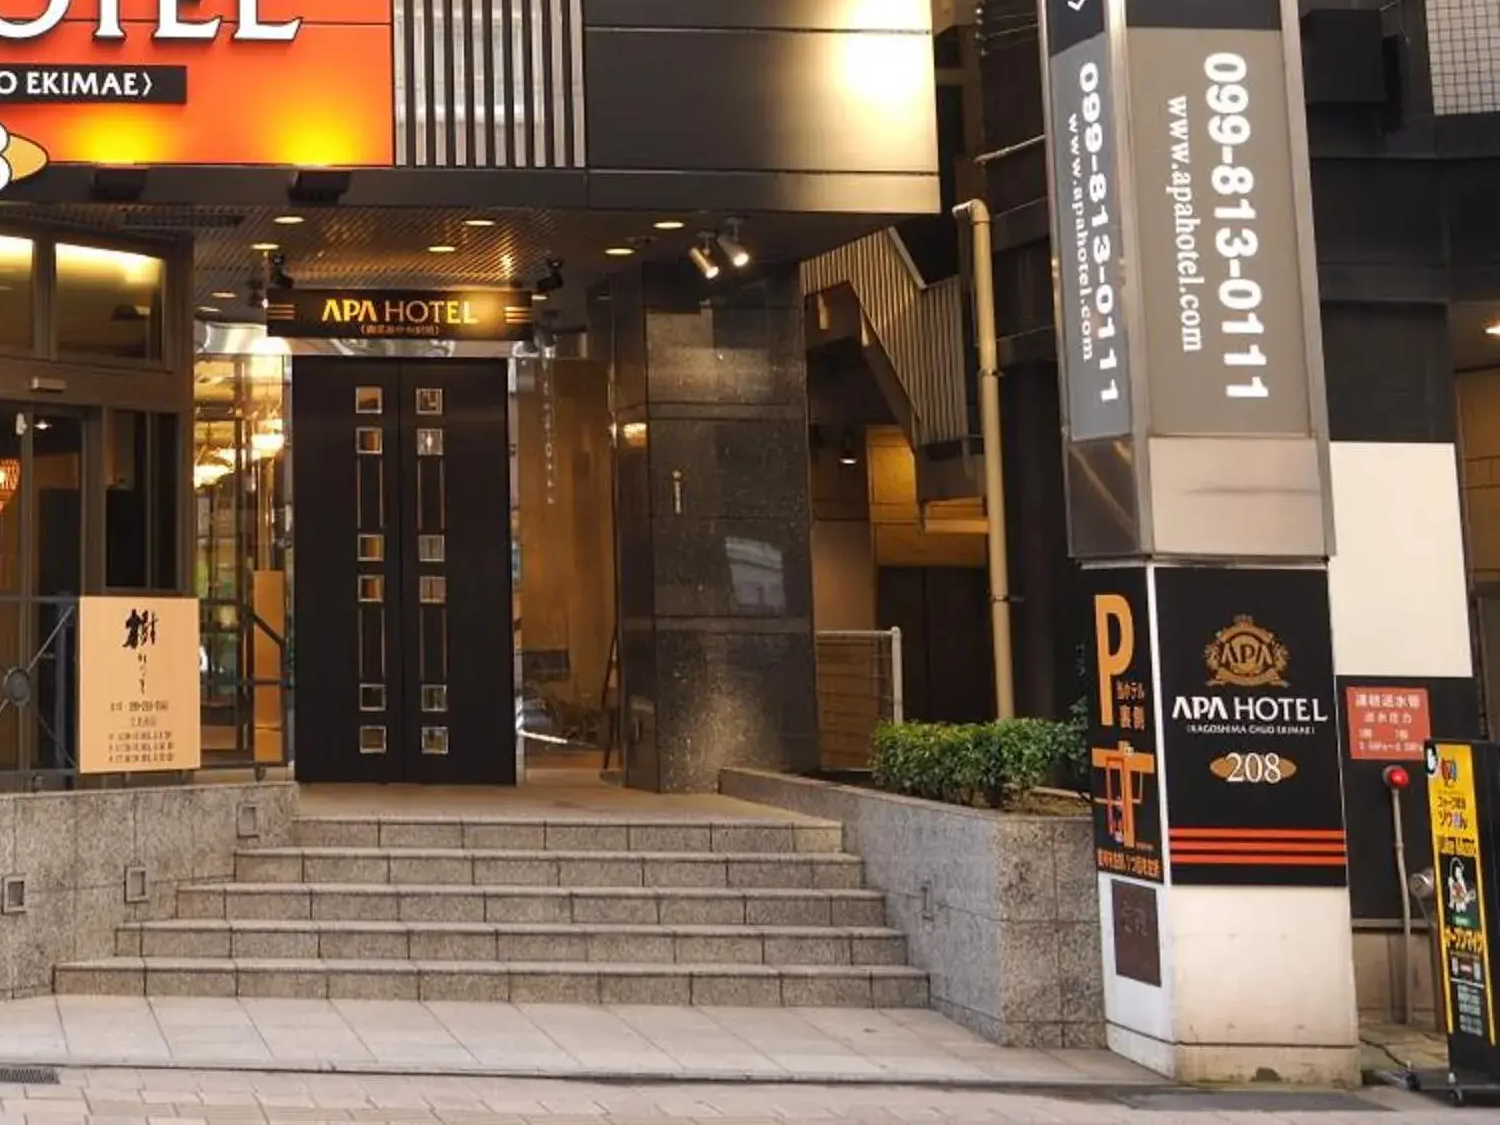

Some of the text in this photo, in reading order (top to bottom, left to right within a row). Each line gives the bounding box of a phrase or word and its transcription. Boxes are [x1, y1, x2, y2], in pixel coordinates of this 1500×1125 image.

[321, 298, 480, 324] APA HOTEL
[1067, 114, 1093, 361] www.apahotel.com
[1079, 61, 1120, 401] 099-813-0111
[1166, 95, 1205, 352] www.apahotel.com
[1203, 52, 1269, 398] 099-813-0111
[1095, 594, 1135, 727] P
[1172, 696, 1329, 723] APA HOTEL
[1225, 752, 1283, 784] 208
